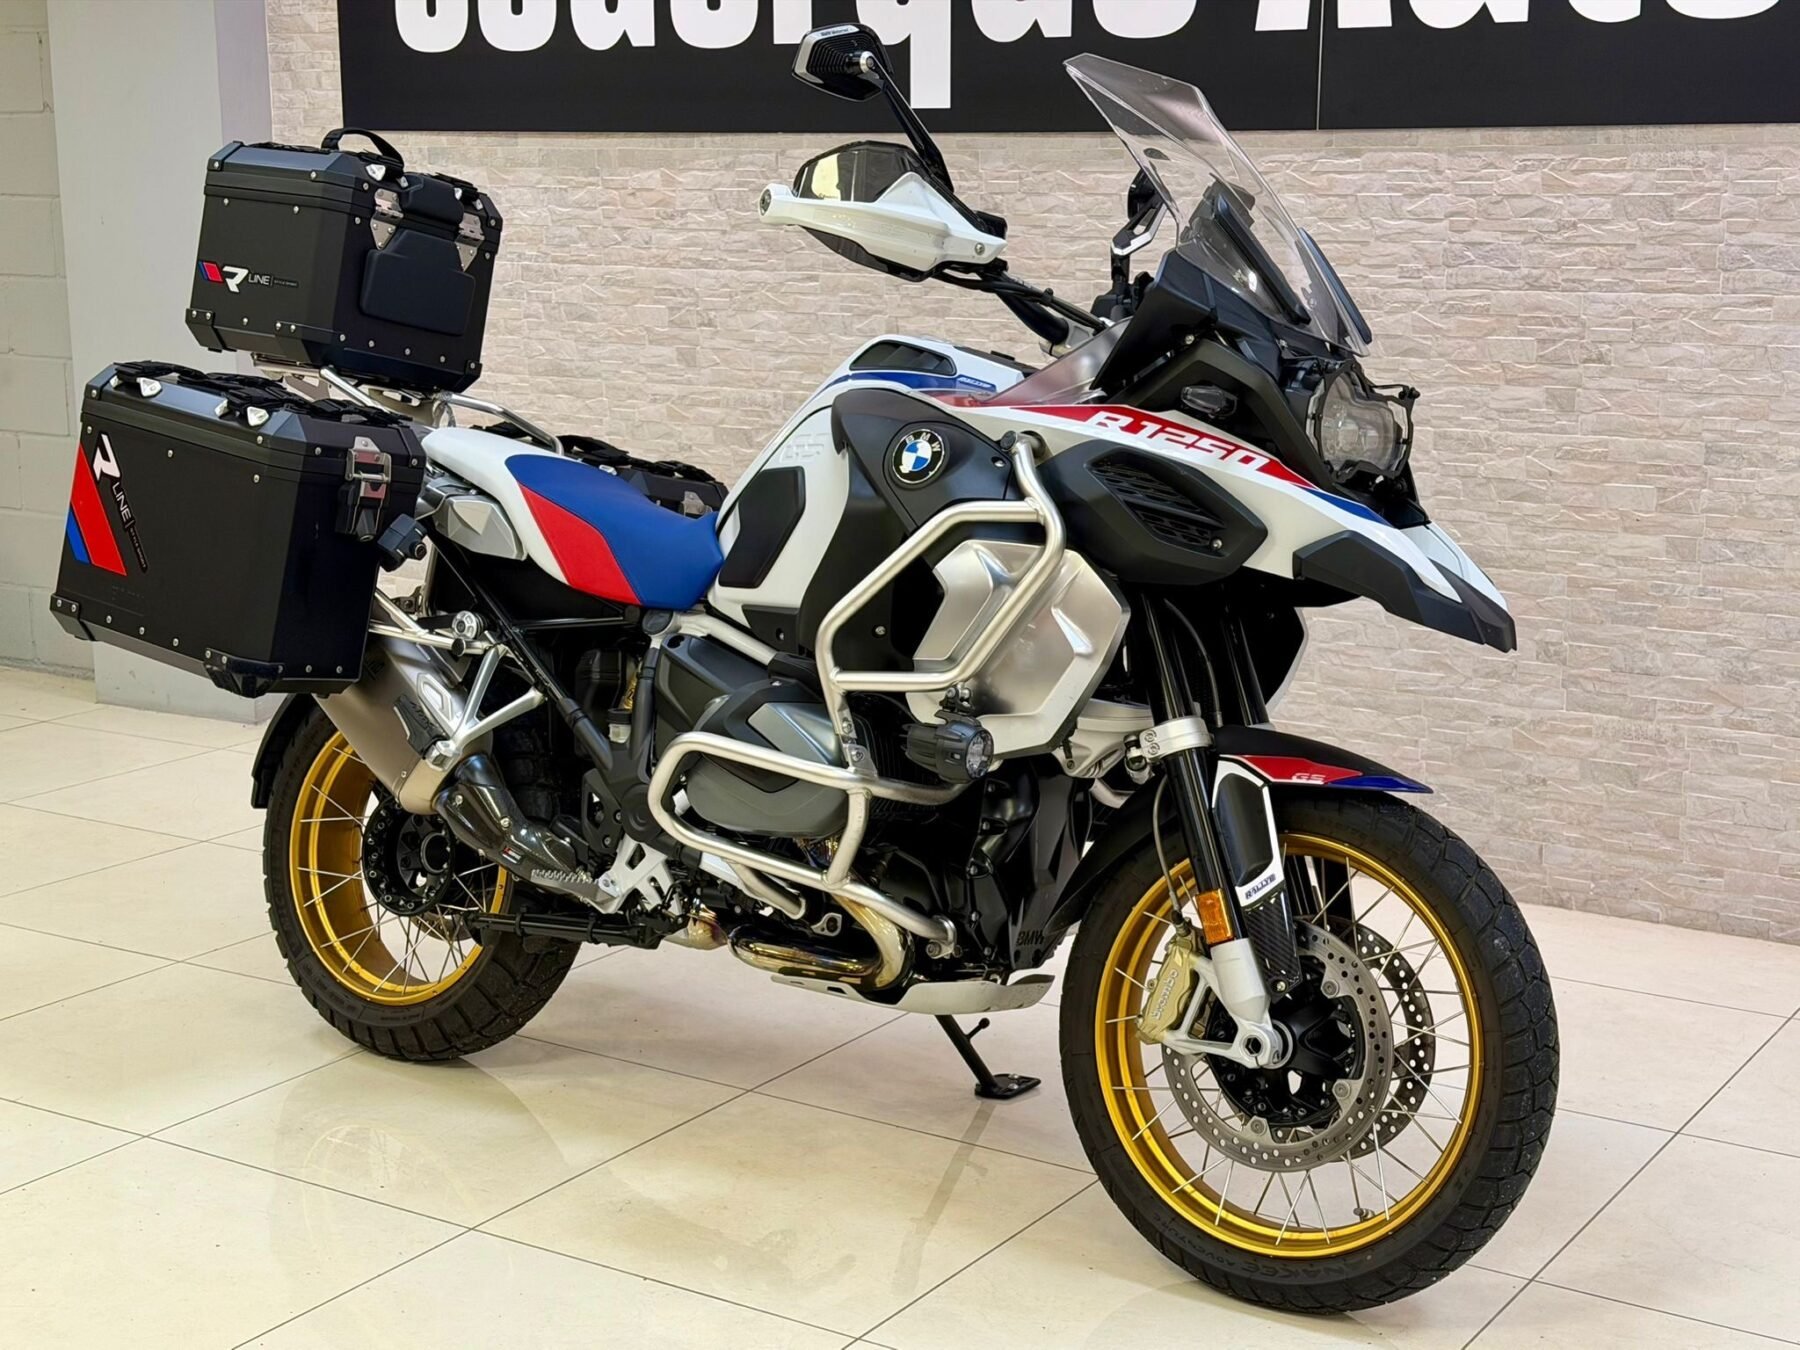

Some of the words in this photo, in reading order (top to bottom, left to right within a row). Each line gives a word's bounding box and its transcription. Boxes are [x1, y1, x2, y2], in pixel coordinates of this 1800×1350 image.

[222, 265, 249, 293] R
[248, 273, 271, 285] LINE
[905, 432, 942, 452] BMW
[112, 481, 132, 521] LINE
[1291, 772, 1326, 785] GS
[1245, 873, 1277, 900] RALLYE
[1016, 930, 1044, 946] BMW
[1151, 969, 1179, 1020] brembo
